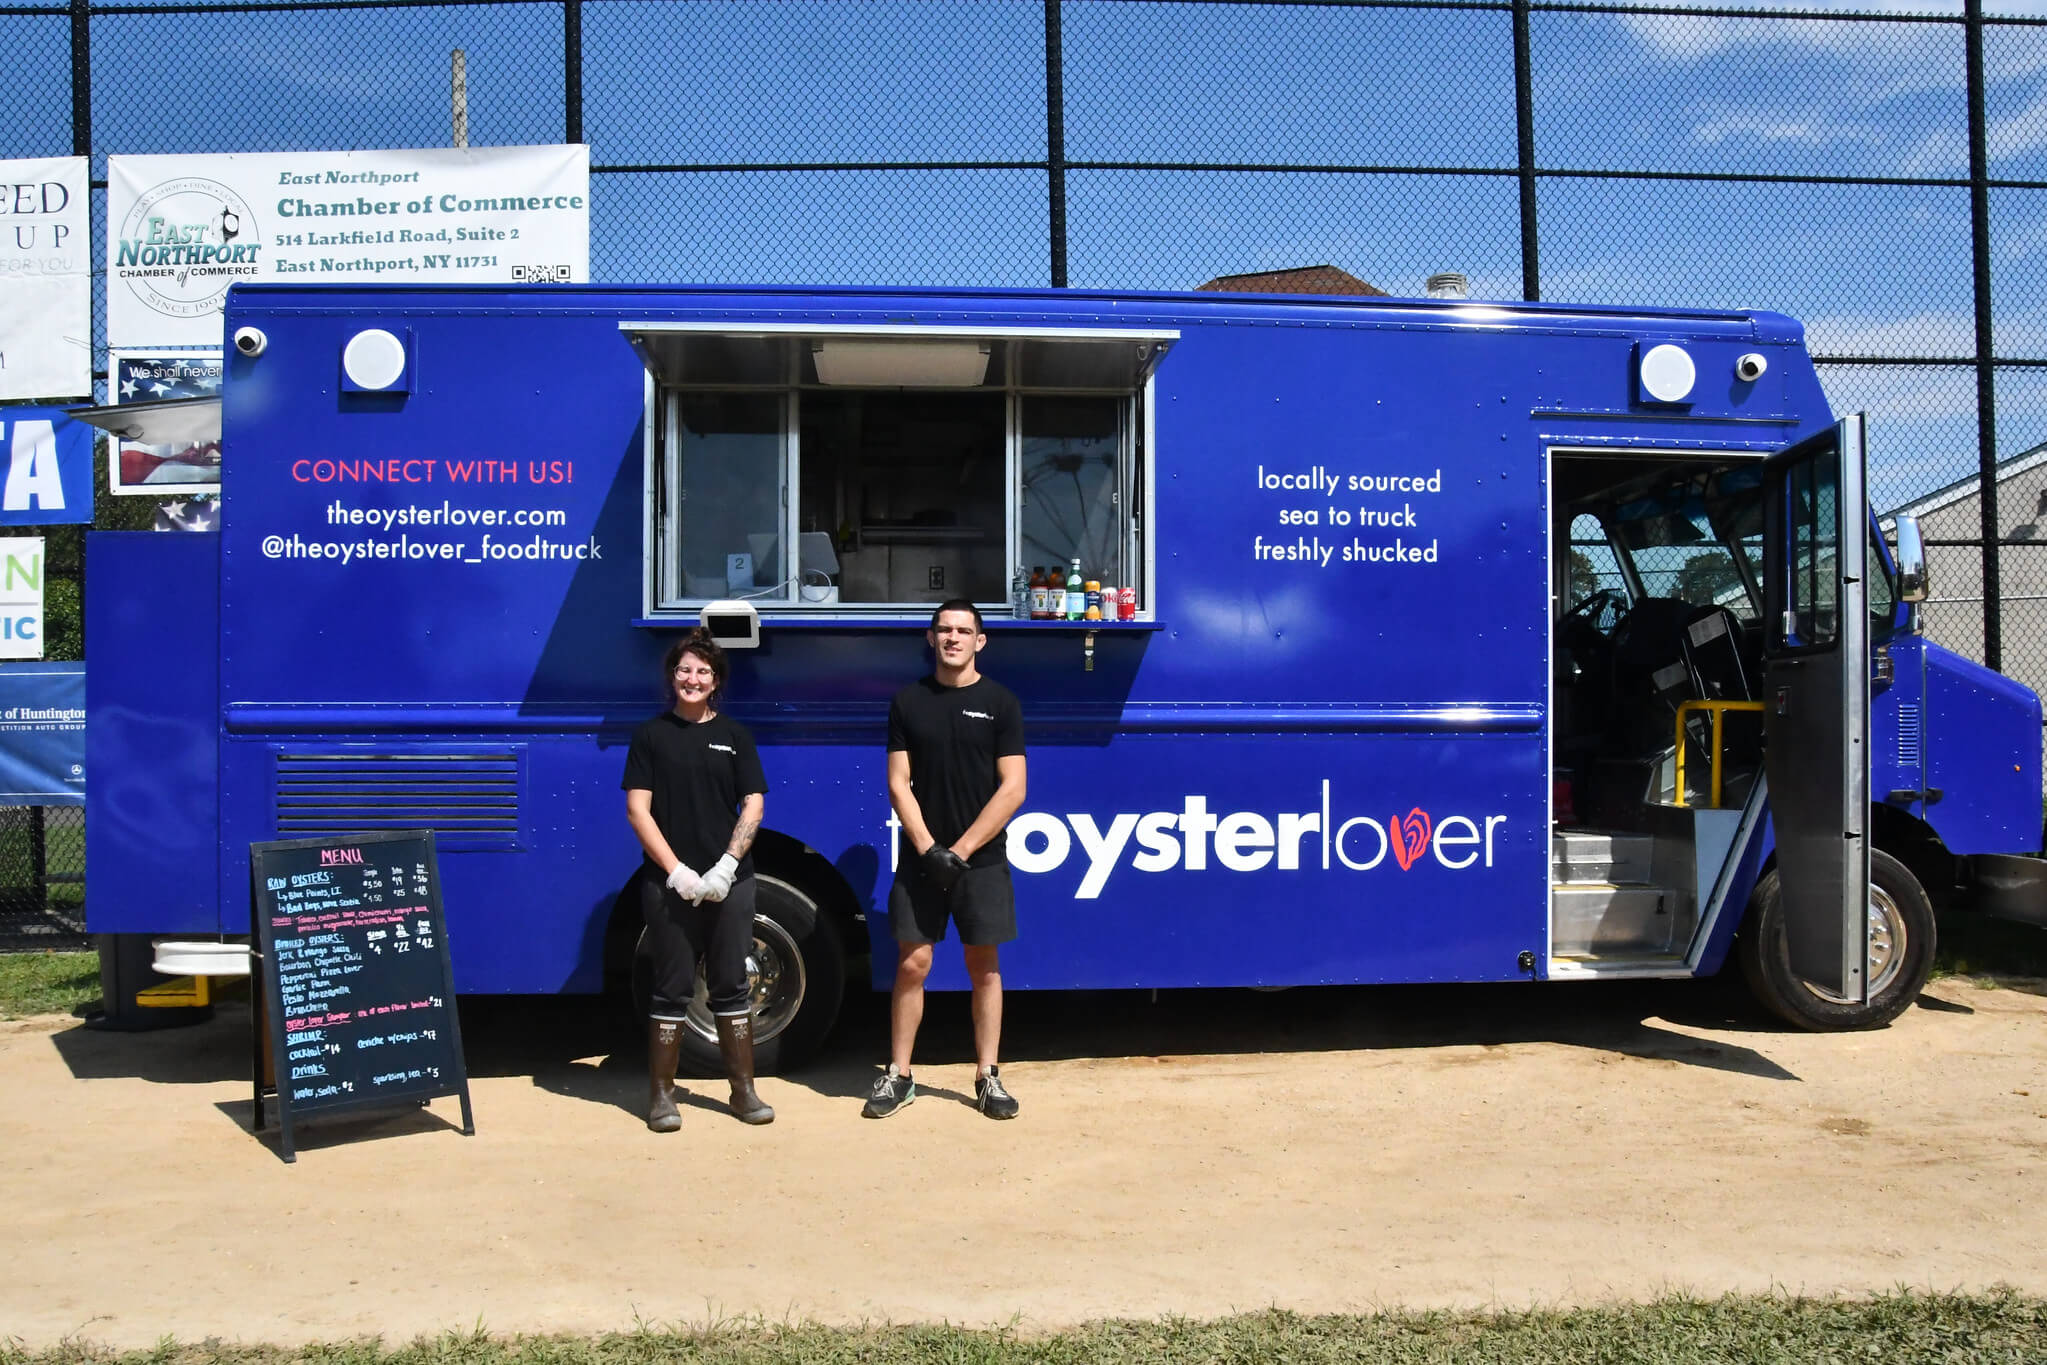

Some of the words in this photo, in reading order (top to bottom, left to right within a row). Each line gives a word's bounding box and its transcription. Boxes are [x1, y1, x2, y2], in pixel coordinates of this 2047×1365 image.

[278, 171, 321, 185] East
[325, 170, 420, 186] Northport
[277, 196, 400, 217] Chamber
[406, 196, 433, 214] of
[439, 193, 583, 212] Commerce
[276, 233, 303, 246] 514
[308, 230, 394, 246] Larkfield
[400, 229, 452, 244] Road,
[456, 226, 505, 241] Suite
[510, 228, 520, 240] 2
[276, 259, 316, 273] East
[320, 257, 420, 273] Northport,
[422, 255, 452, 269] NY
[456, 256, 498, 268] 11731
[120, 268, 175, 278] CHAMBER
[177, 266, 190, 288] of
[191, 267, 258, 276] COMMERCE
[129, 366, 150, 379] We
[154, 366, 180, 378] shall
[184, 367, 220, 376] never
[292, 460, 436, 482] CONNECT
[446, 460, 517, 483] WITH
[529, 462, 572, 484] US!
[1258, 465, 1340, 496] locally
[1349, 469, 1440, 492] sourced
[327, 500, 566, 531] theoysterlover.com
[1280, 509, 1318, 525] sea
[1328, 506, 1350, 526] to
[1360, 503, 1416, 527] truck
[262, 534, 602, 564] @theoysterlover_foodtruck
[1254, 536, 1334, 568] freshly
[1342, 538, 1438, 562] shucked
[736, 558, 744, 570] 2
[5, 708, 18, 719] of
[321, 848, 364, 864] MENU
[268, 877, 287, 890] RAW
[394, 942, 410, 953] $22
[416, 938, 434, 949] $42
